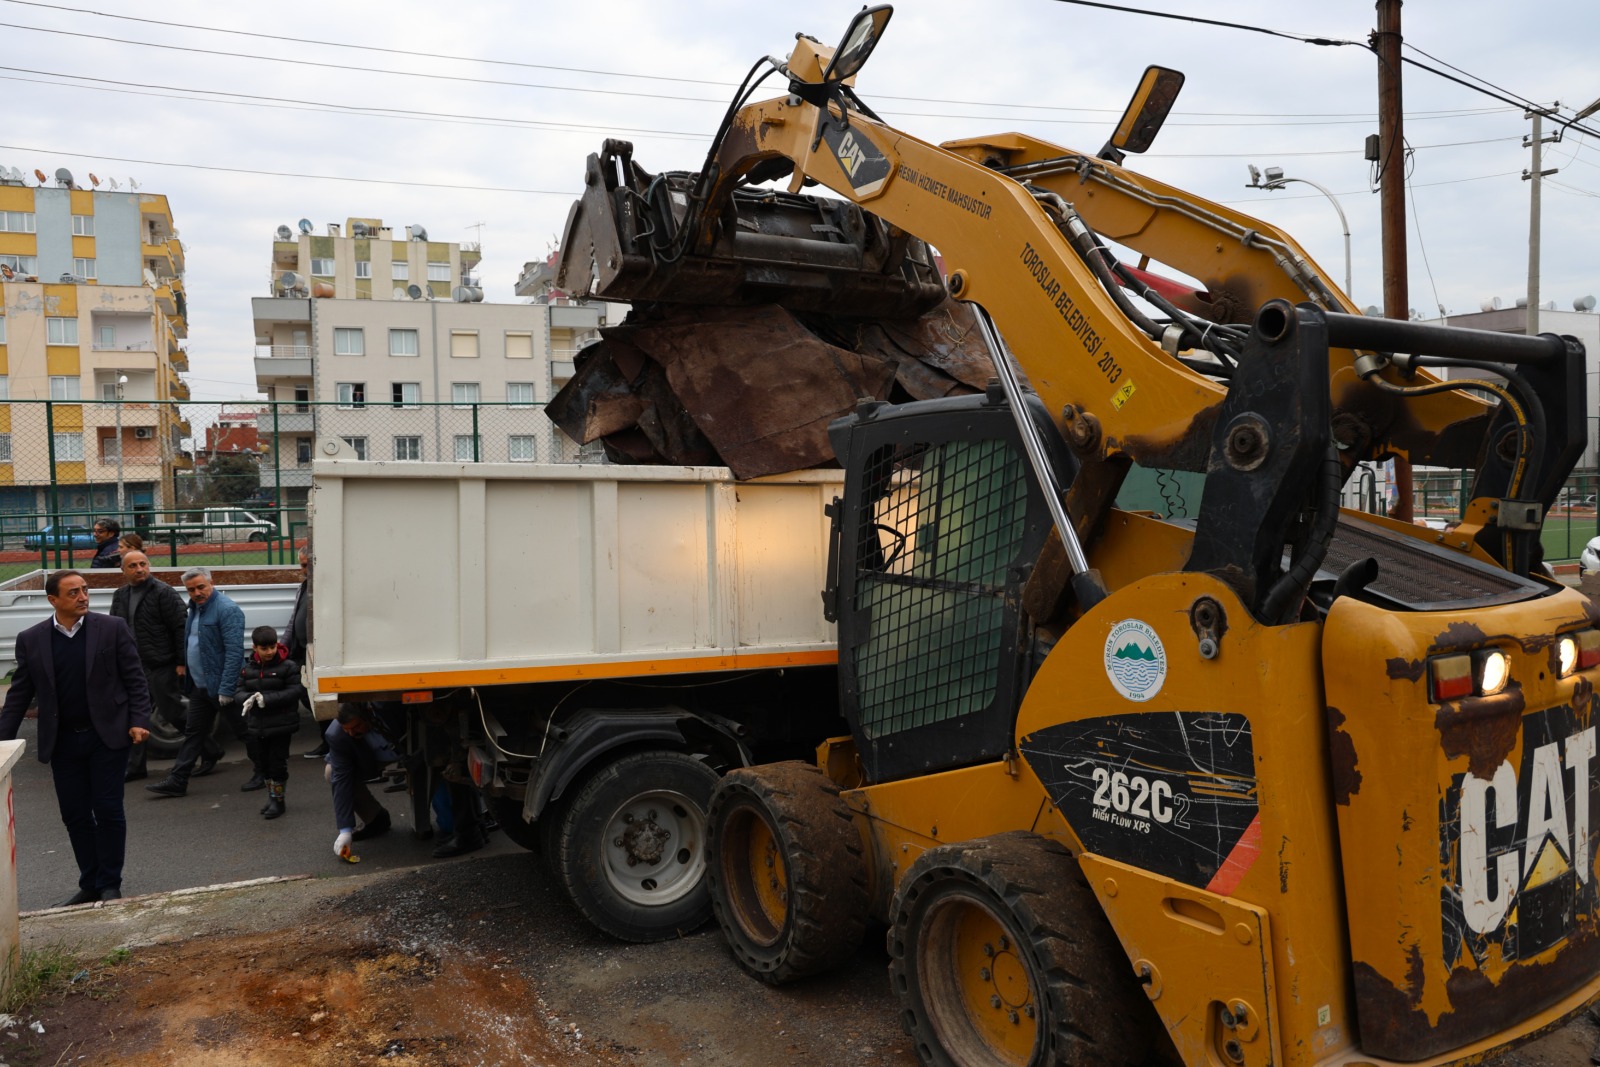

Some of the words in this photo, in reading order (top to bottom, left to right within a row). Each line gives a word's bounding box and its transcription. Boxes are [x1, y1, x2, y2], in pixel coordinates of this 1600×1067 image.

[838, 131, 866, 179] CAT
[947, 187, 992, 220] MAHSUSTUR
[1019, 242, 1061, 301] TOROSLAR
[1055, 291, 1106, 357] BELEDİYESİ
[1096, 351, 1123, 384] 2013
[1111, 622, 1144, 639] TOROSLAR
[1092, 808, 1110, 822] HIGH
[1132, 819, 1151, 834] XPS
[1459, 726, 1597, 934] CAT
